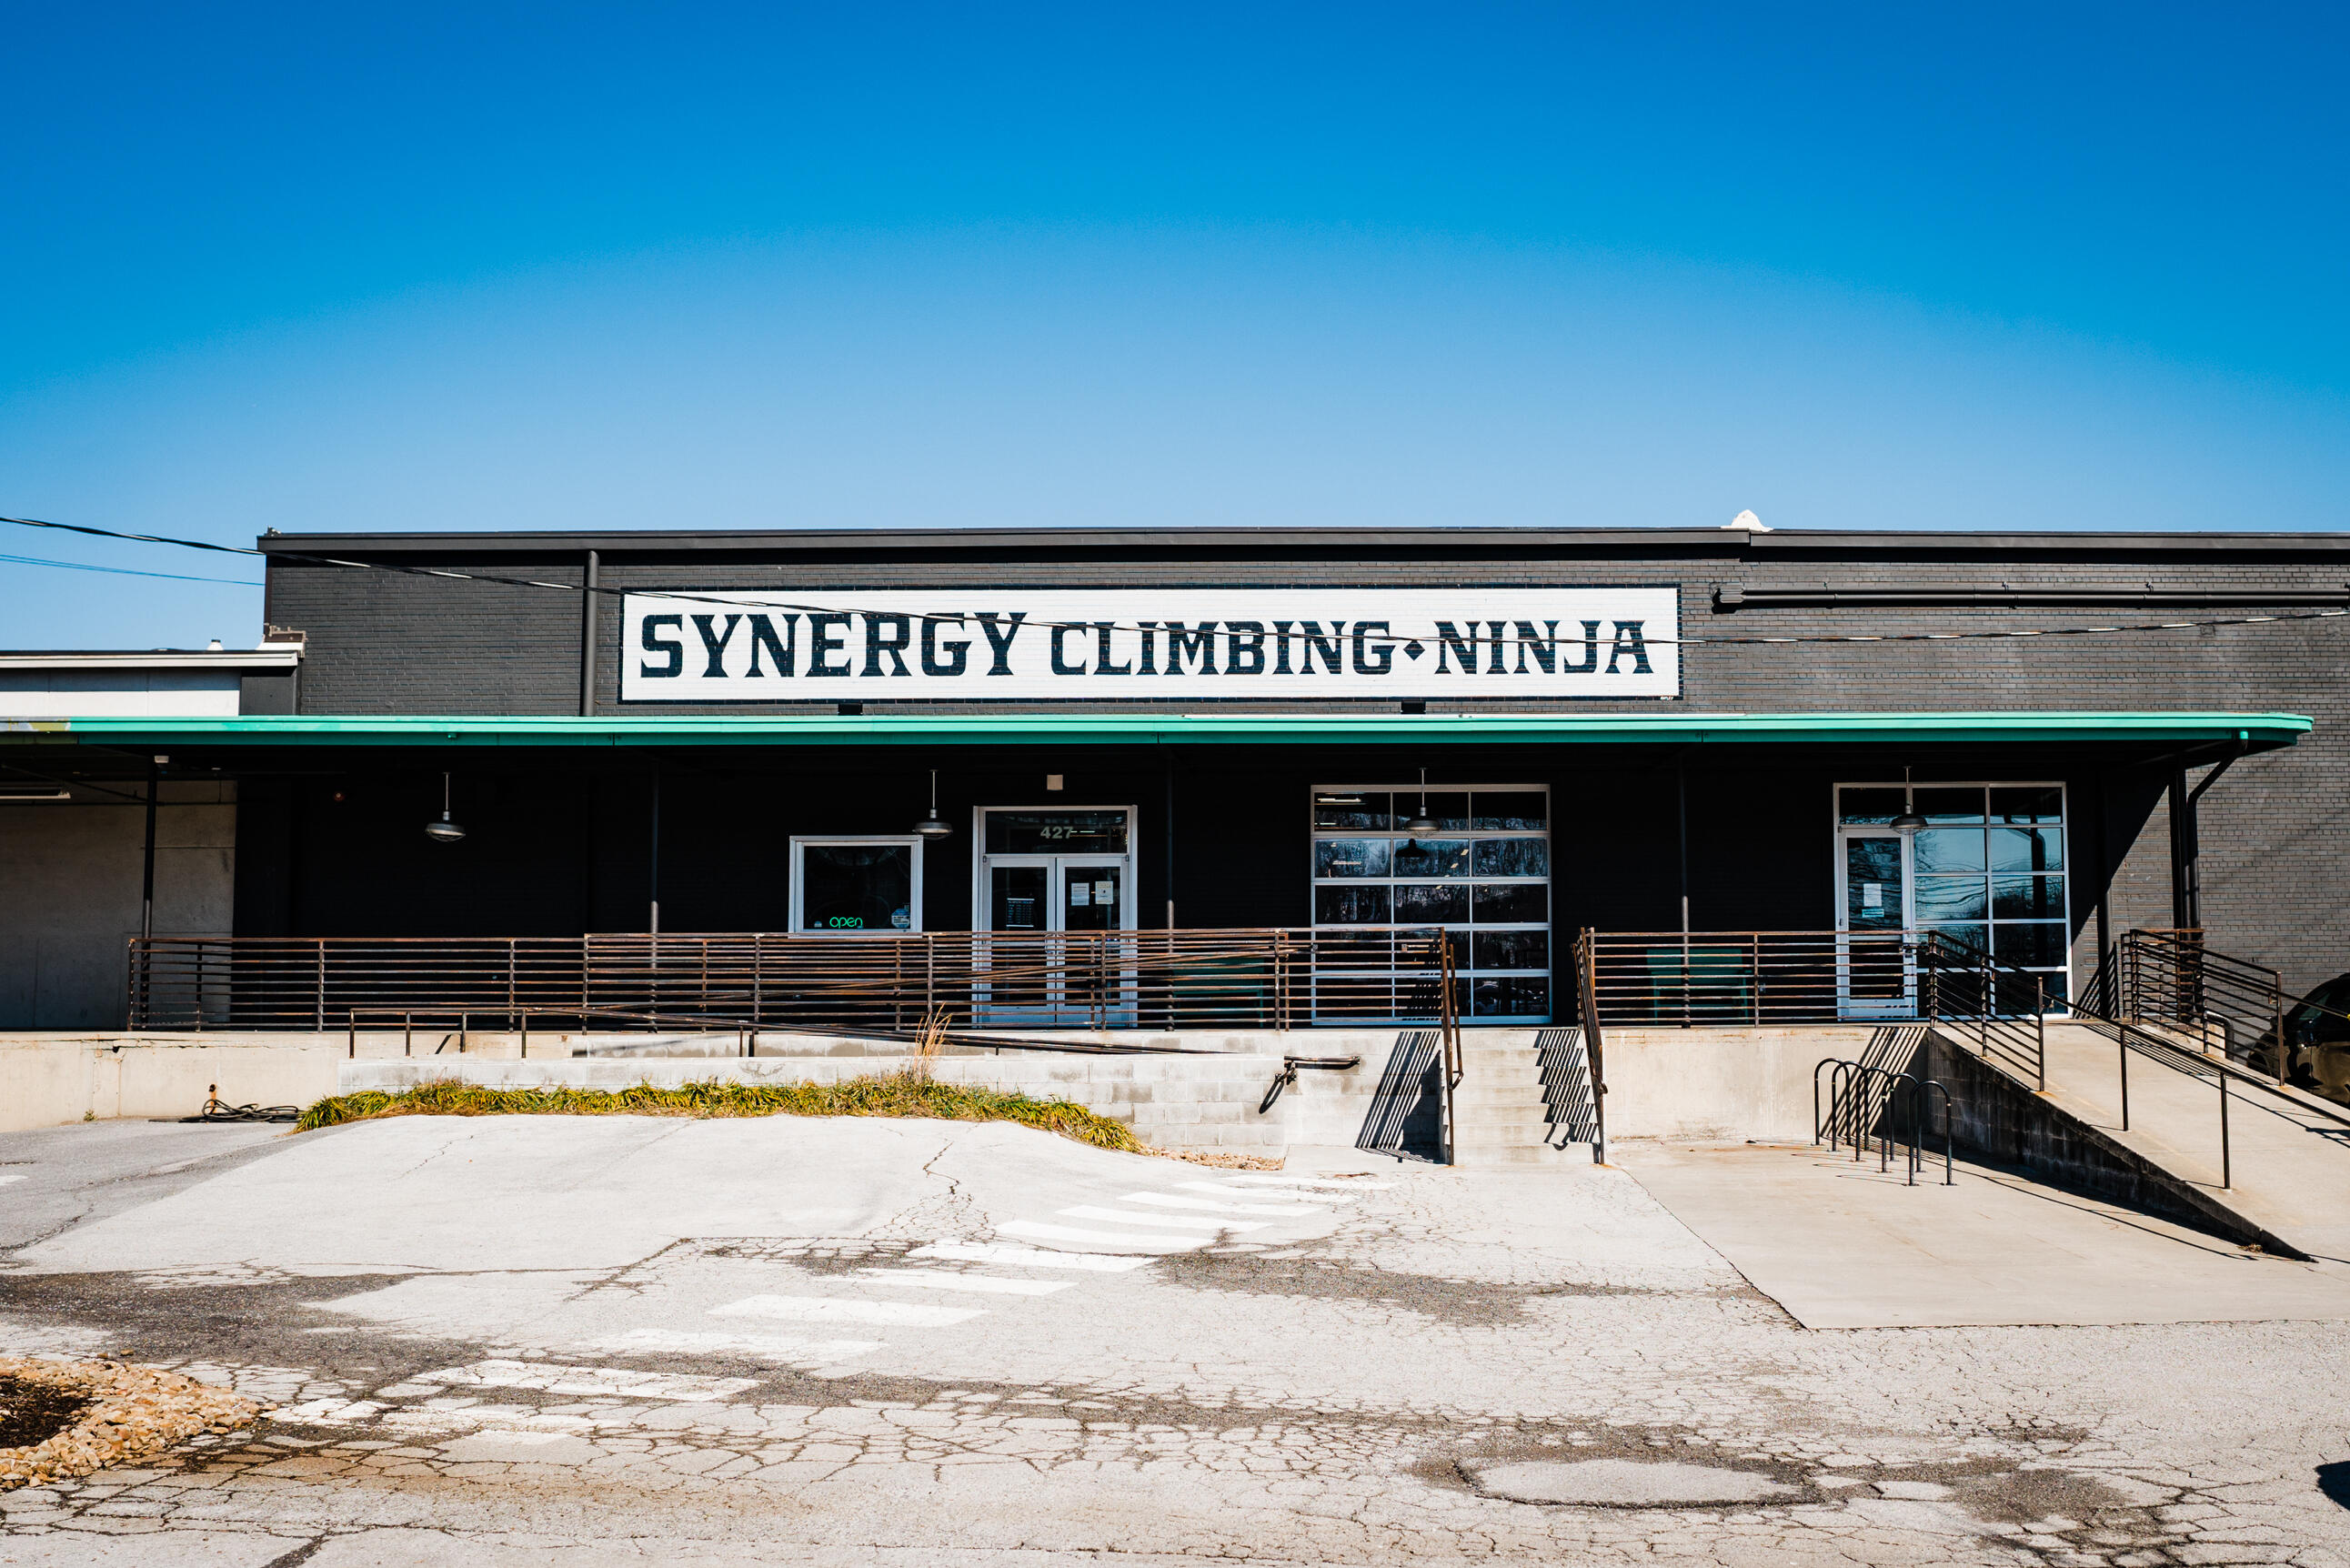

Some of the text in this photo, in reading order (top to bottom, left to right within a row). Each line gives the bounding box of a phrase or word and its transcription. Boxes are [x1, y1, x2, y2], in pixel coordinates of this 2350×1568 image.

[640, 612, 1654, 678] SYNERGY CLIMBING NINJA
[1039, 825, 1074, 839] 427
[829, 916, 864, 929] open
